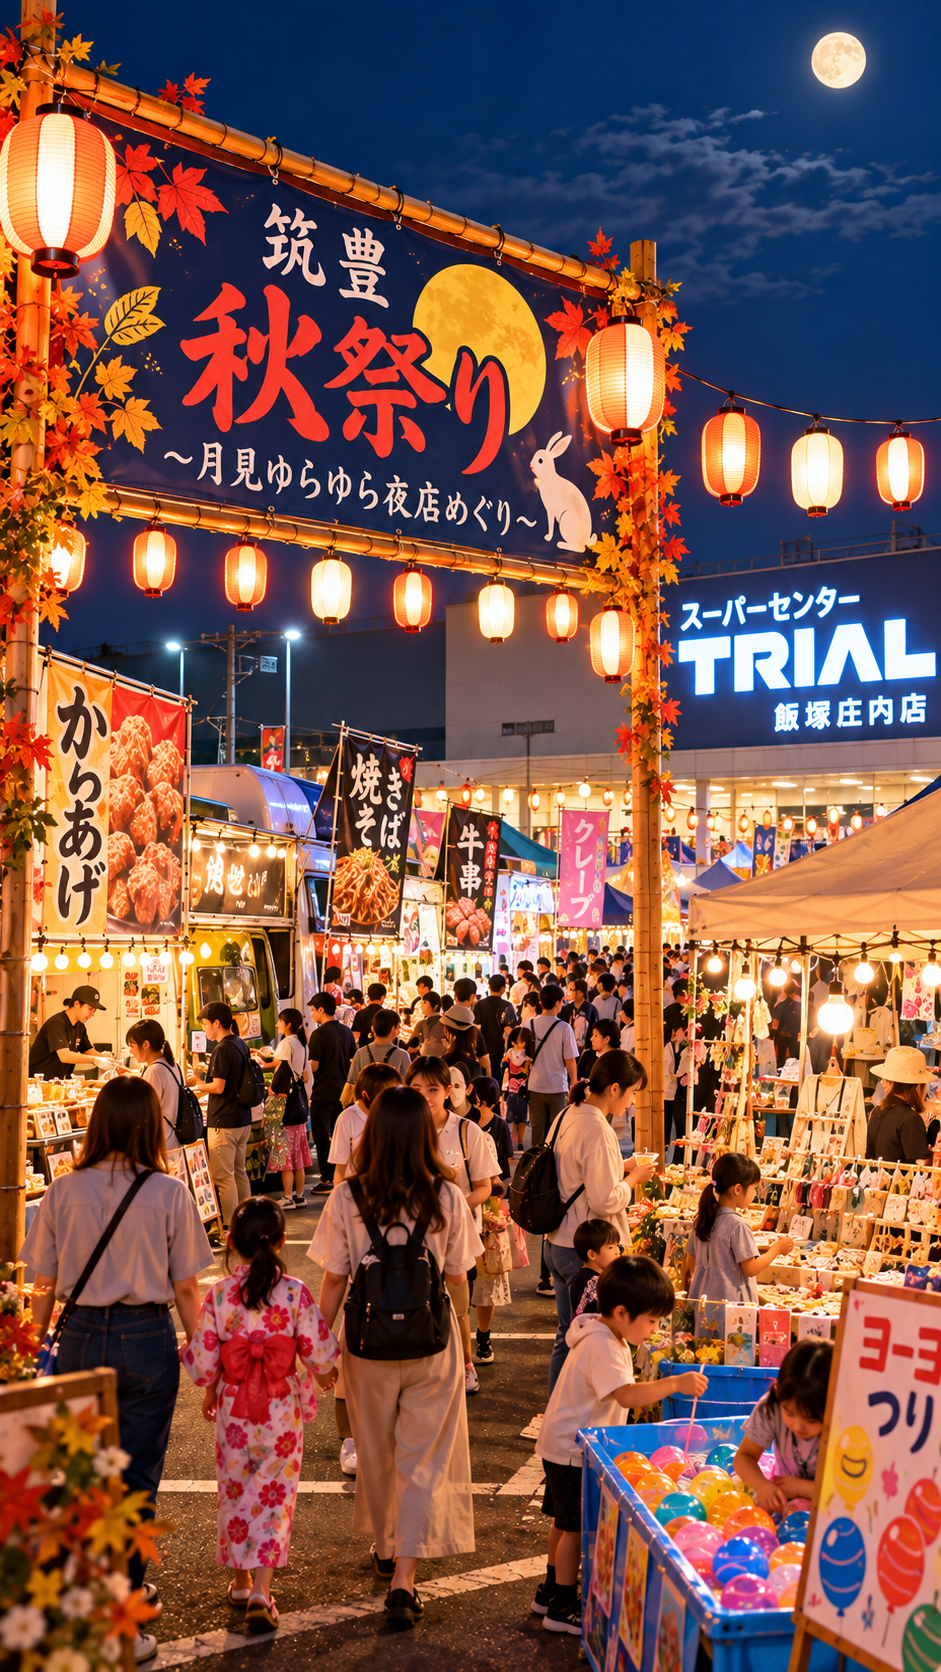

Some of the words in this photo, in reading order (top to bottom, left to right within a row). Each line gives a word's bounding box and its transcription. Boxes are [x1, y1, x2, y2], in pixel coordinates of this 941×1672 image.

[262, 202, 390, 309] 筑豊
[180, 282, 507, 475] 秋祭り
[680, 586, 861, 632] スーパーセンター
[678, 618, 937, 696] TRIAL
[774, 693, 927, 732] 飯塚庄内店
[57, 686, 107, 926] からあげ
[456, 822, 485, 898] 牛串
[868, 1391, 934, 1453] つり
